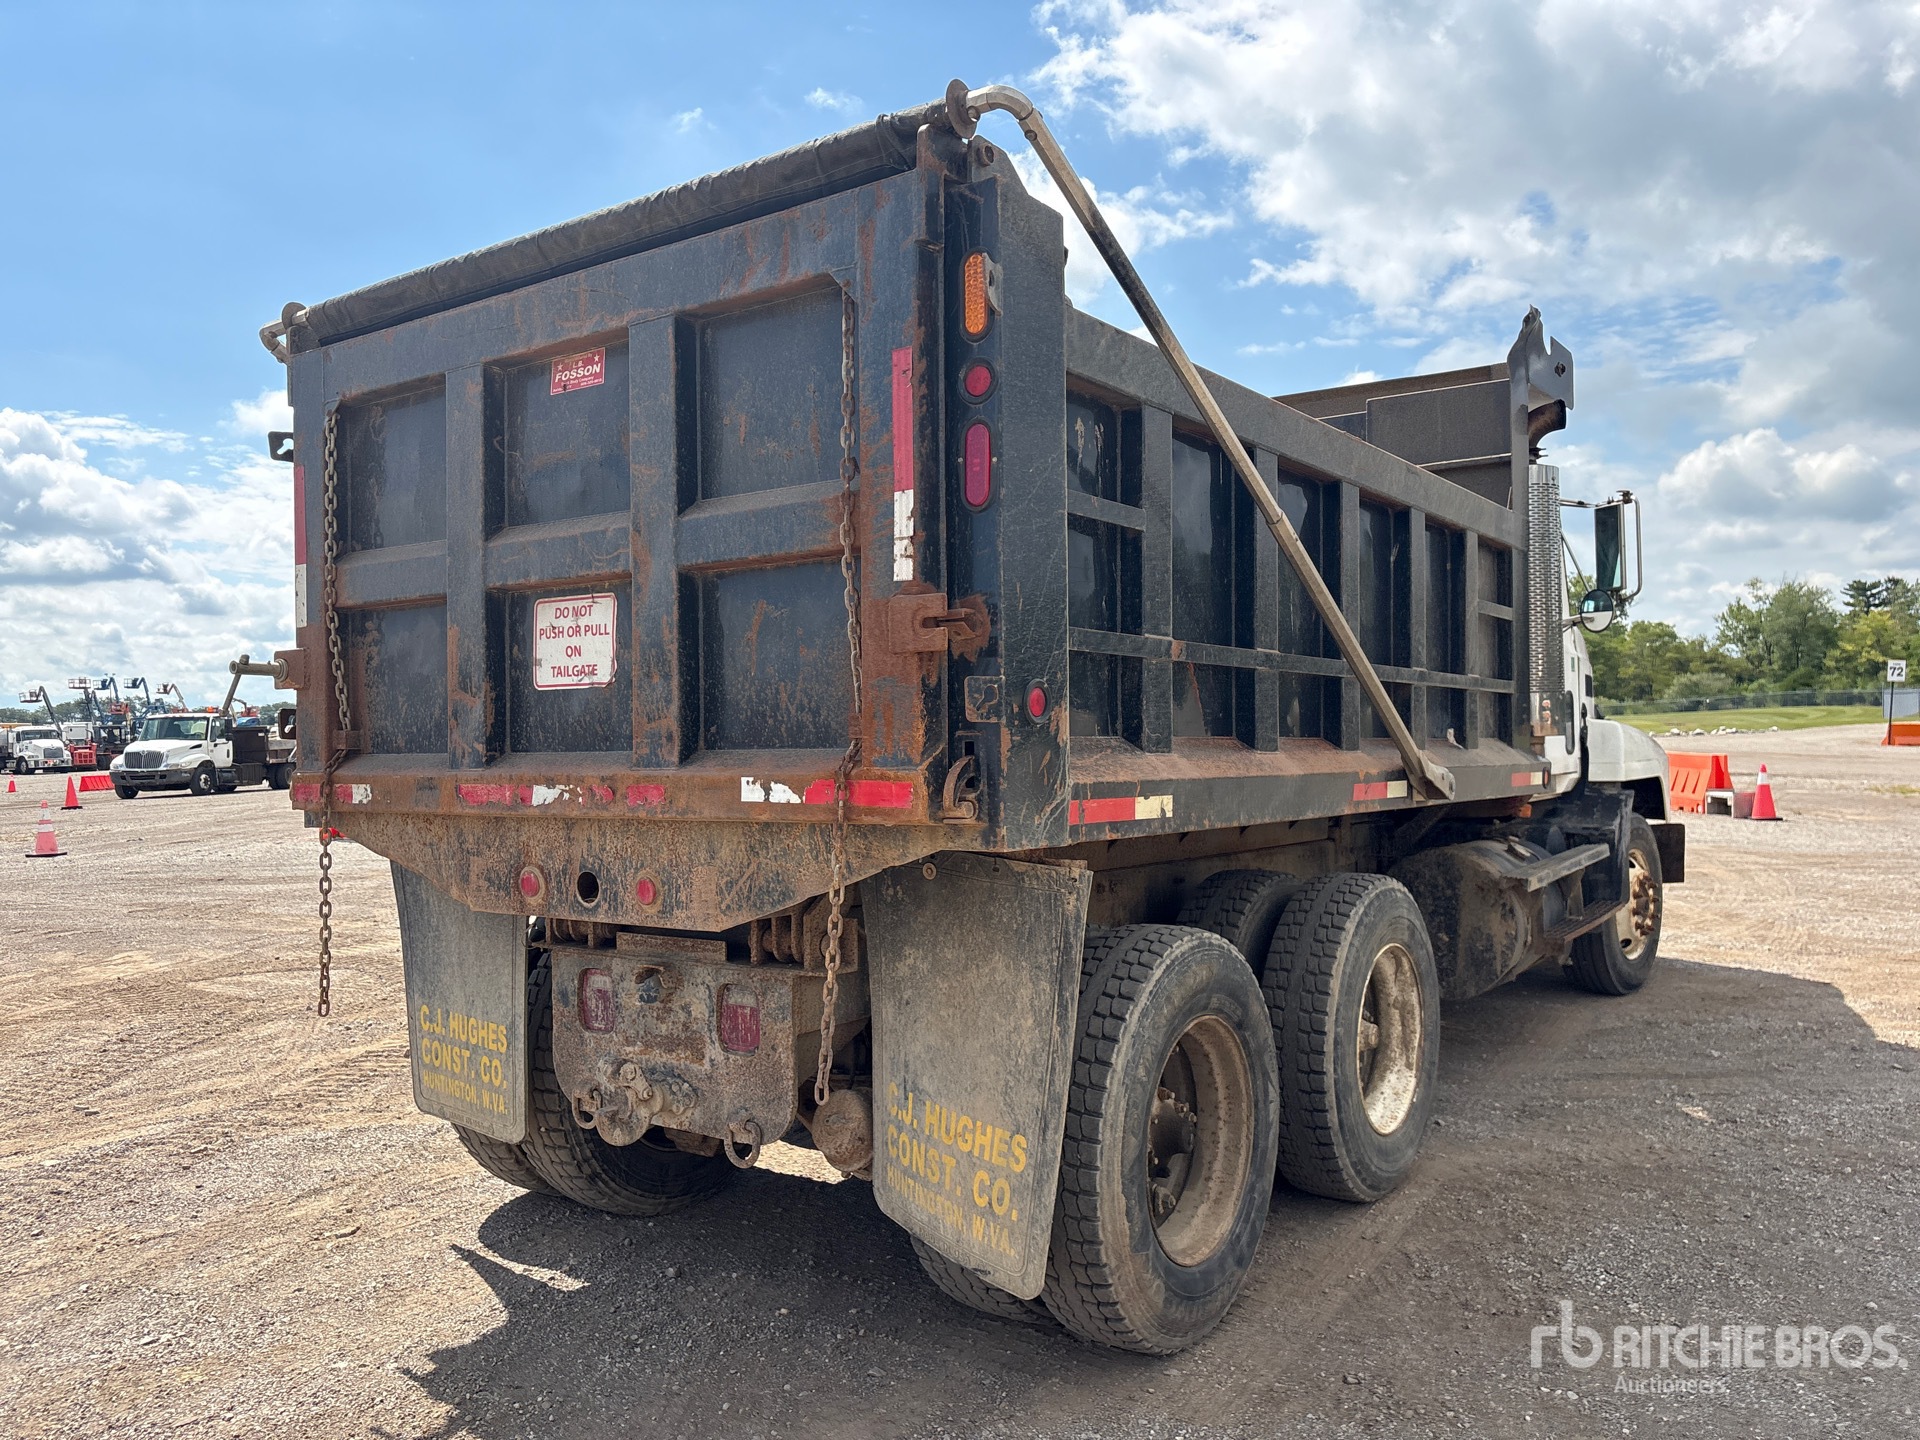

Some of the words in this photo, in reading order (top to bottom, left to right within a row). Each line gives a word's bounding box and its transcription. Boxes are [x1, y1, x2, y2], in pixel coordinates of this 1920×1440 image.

[555, 363, 601, 383] FOSSON
[554, 606, 570, 620] DO
[571, 604, 594, 618] NOT
[539, 626, 565, 641] PUSH
[566, 624, 582, 638] OR
[584, 623, 610, 637] PULL
[565, 645, 582, 659] ON
[551, 664, 598, 678] TAILGATE
[1889, 666, 1904, 677] 72
[420, 1004, 446, 1036] C.J.
[449, 1011, 508, 1054] HUGHES
[422, 1038, 475, 1078] CONST.
[481, 1055, 508, 1089] CO.
[888, 1081, 918, 1129] C.J.
[925, 1100, 1028, 1173] HUGHES
[887, 1124, 962, 1197] CONST.
[973, 1170, 1018, 1222] CO.
